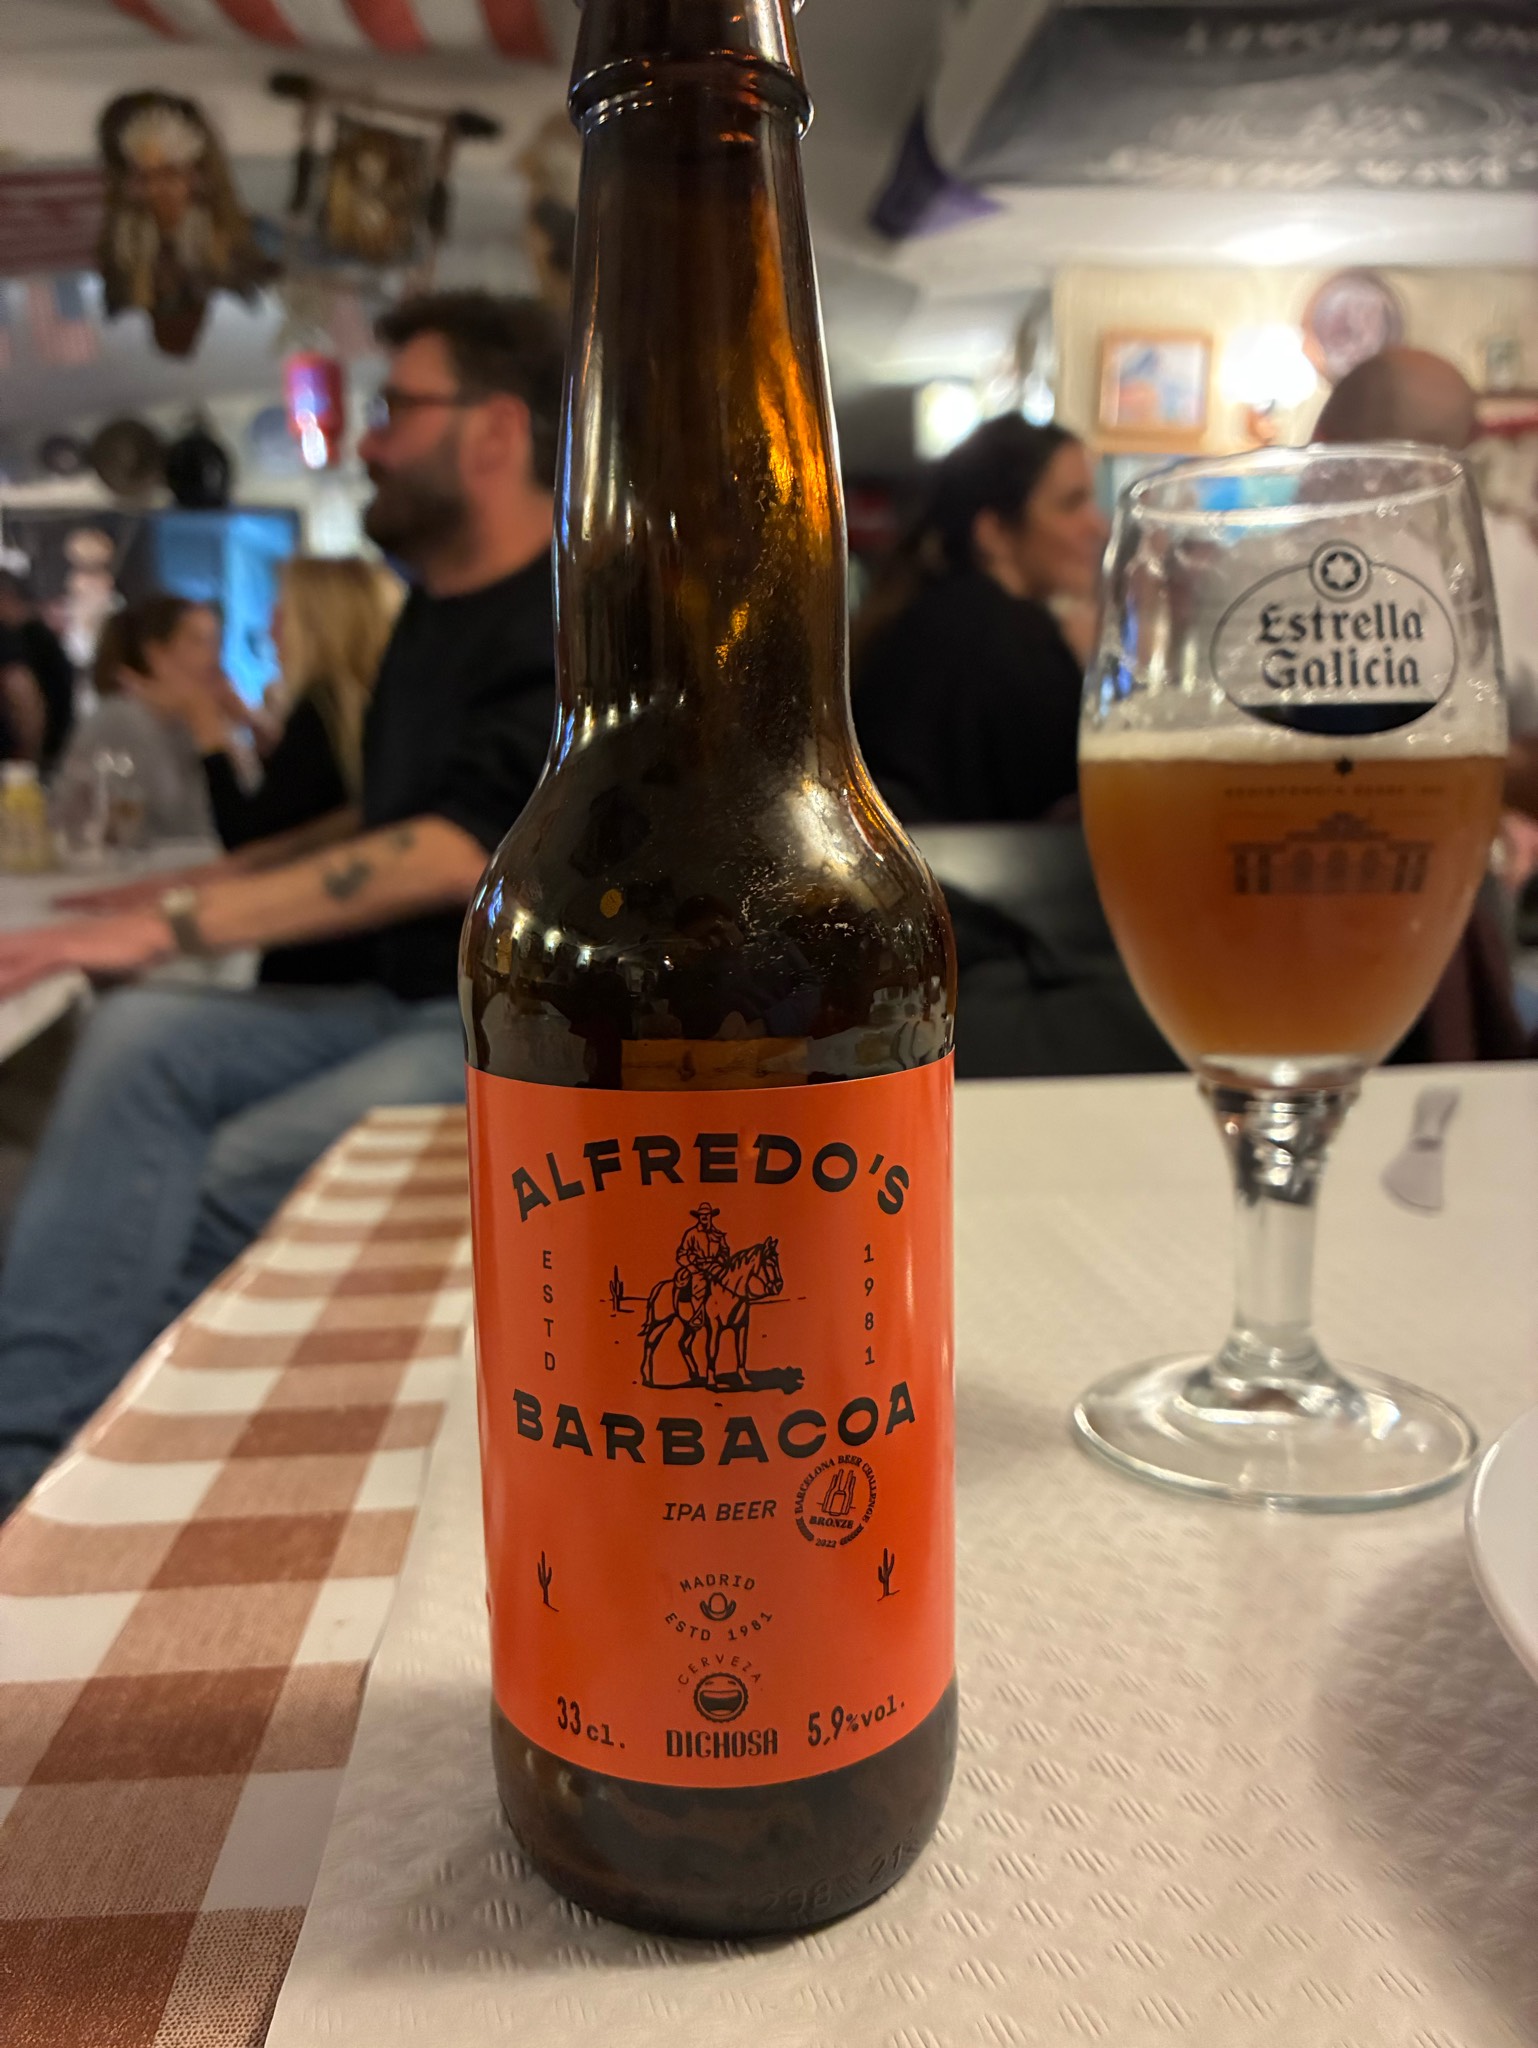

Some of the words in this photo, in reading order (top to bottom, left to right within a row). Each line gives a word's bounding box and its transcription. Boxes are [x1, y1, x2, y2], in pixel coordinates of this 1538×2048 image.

[1257, 603, 1424, 644] Estrella
[1262, 646, 1421, 689] Galicia
[511, 1132, 910, 1222] ALFREDO'S
[542, 1249, 556, 1371] ESTD
[863, 1243, 876, 1365] 1981
[512, 1380, 916, 1466] BARBACOA
[794, 1458, 836, 1515] BARCELONA
[837, 1454, 863, 1467] BEER
[662, 1502, 707, 1522] IPA
[715, 1499, 778, 1522] BEER
[809, 1515, 854, 1529] BRONZE
[679, 1573, 756, 1592] MADRID
[664, 1612, 711, 1641] ESTD
[727, 1611, 773, 1641] 1981
[677, 1653, 763, 1687] CERVEZA
[665, 1727, 779, 1759] DICHOSA
